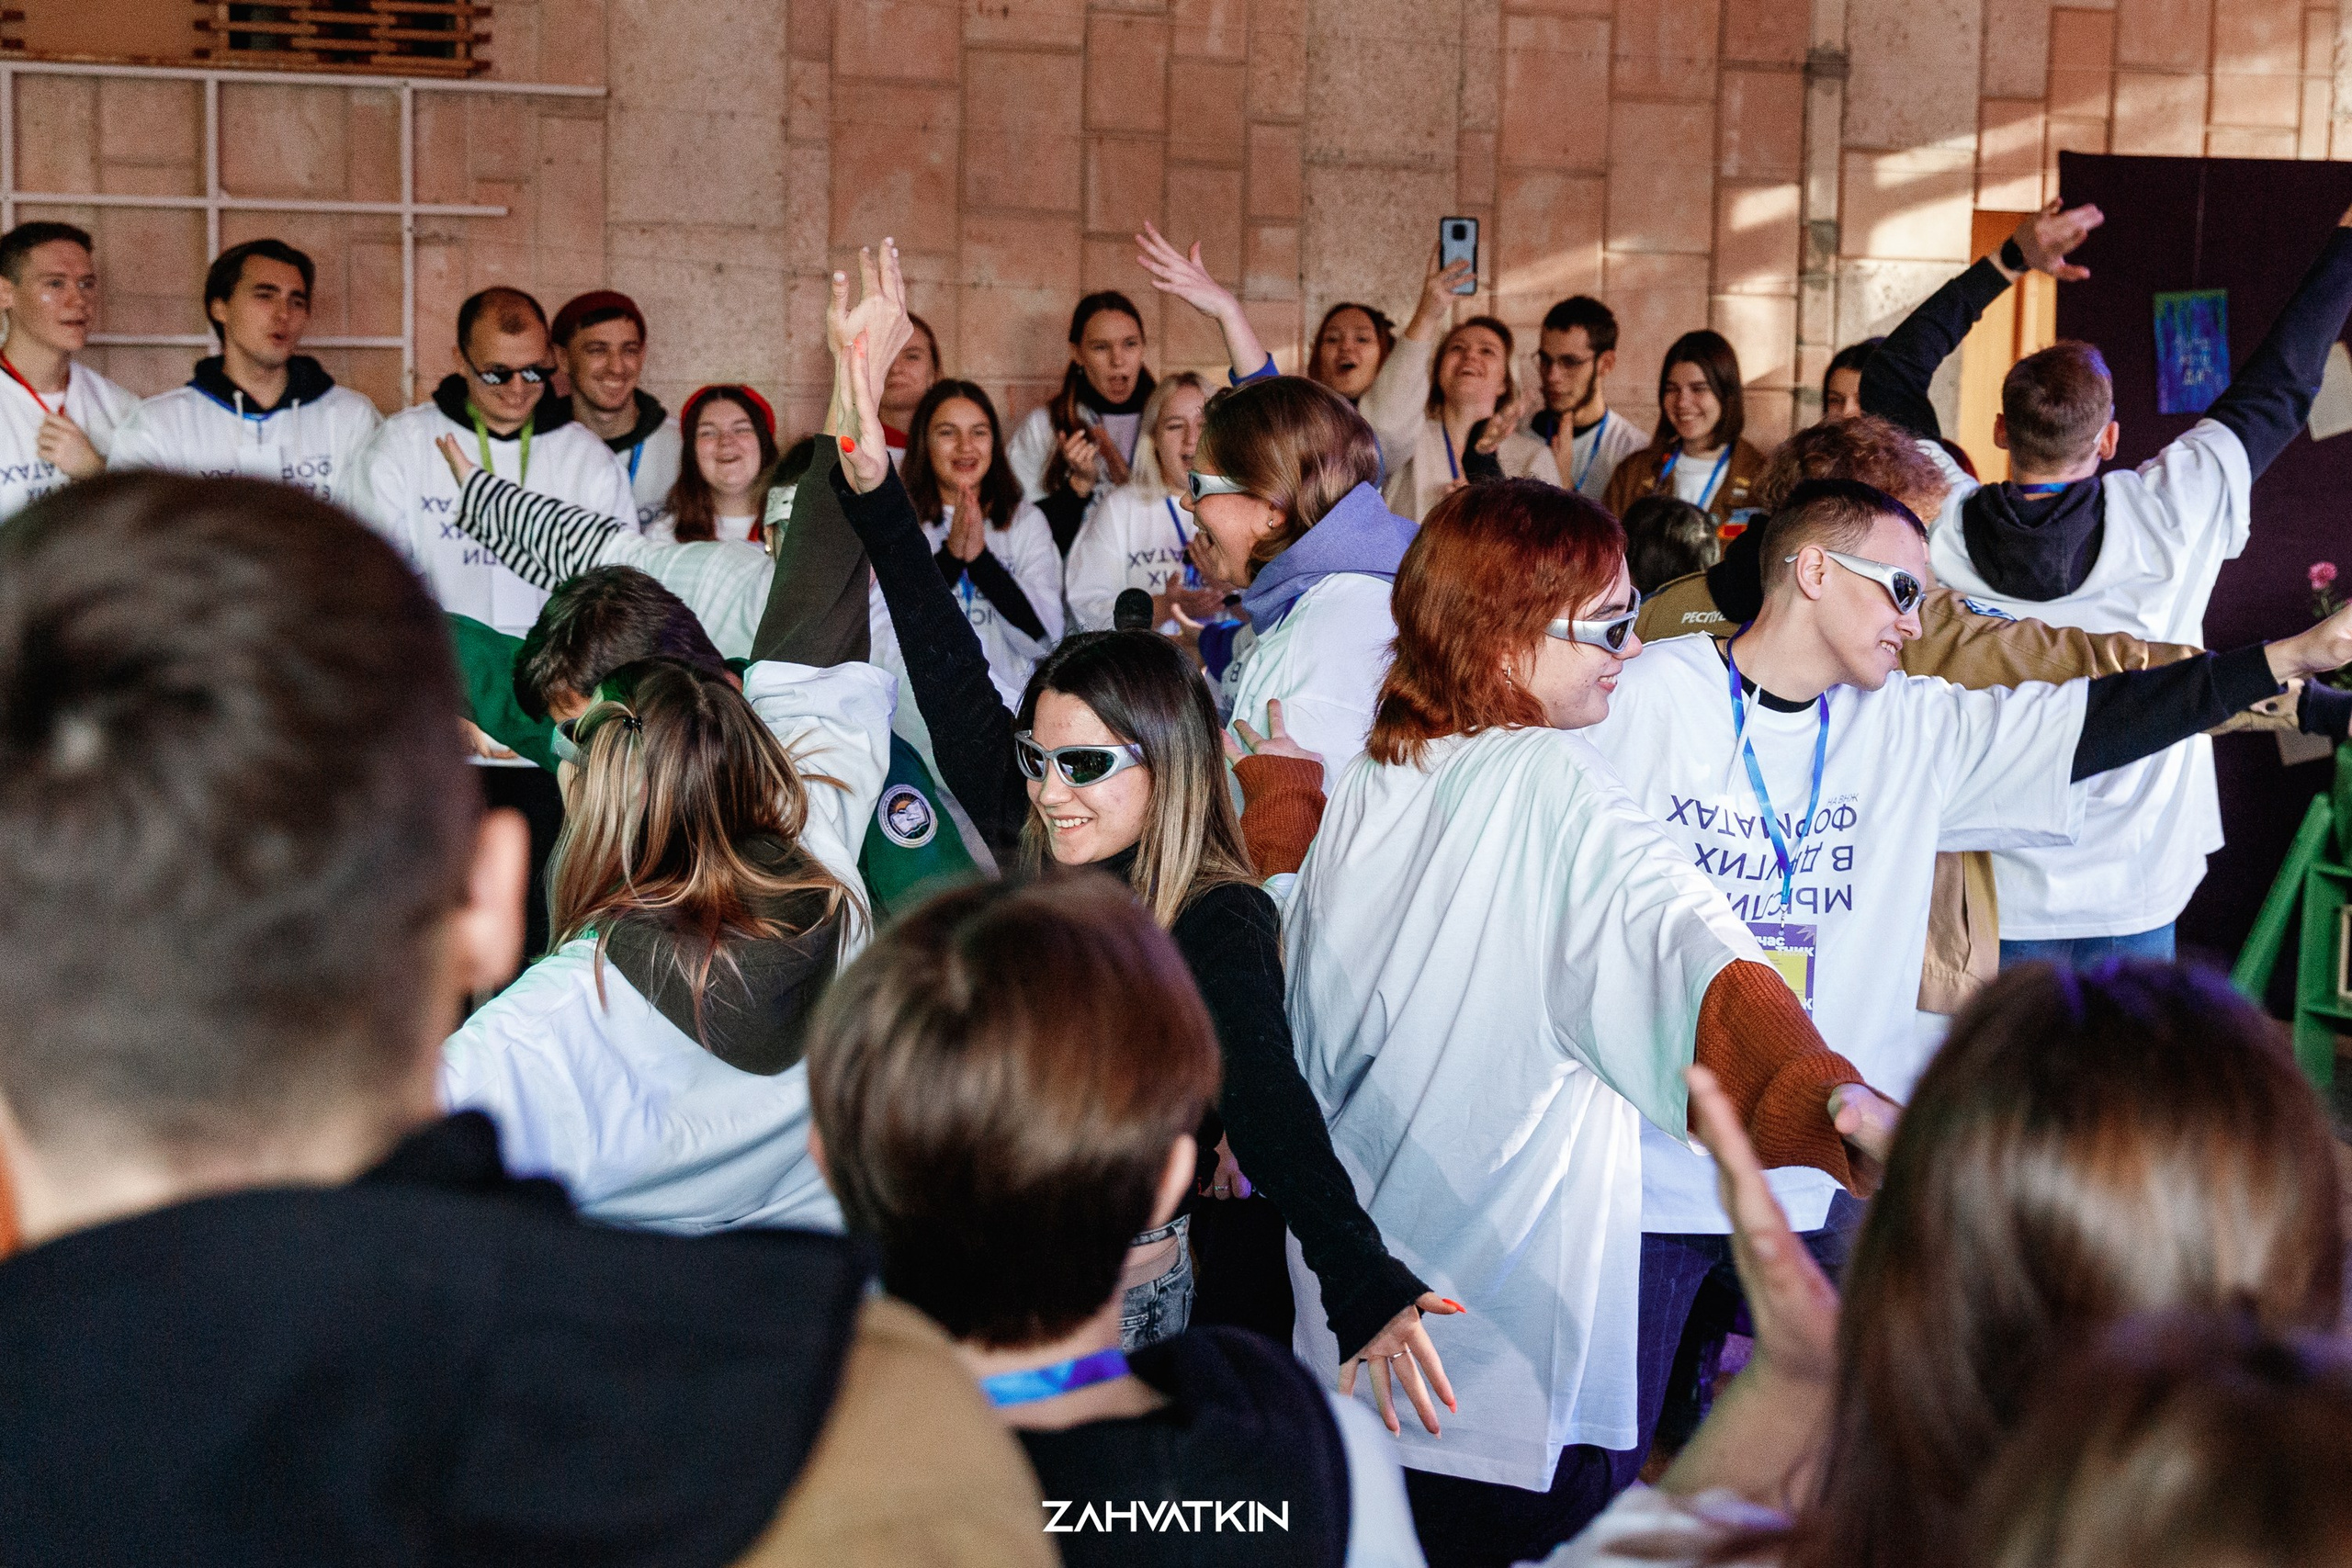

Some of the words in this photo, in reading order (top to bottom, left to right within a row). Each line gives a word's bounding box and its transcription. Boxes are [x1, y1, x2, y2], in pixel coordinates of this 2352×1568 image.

[0, 463, 55, 487] АТАХ
[1126, 547, 1183, 570] АТАХ
[1666, 795, 1858, 839] ФОРМАТАХ
[1831, 845, 1854, 873] В
[1726, 884, 1853, 921] МЫСЛИ
